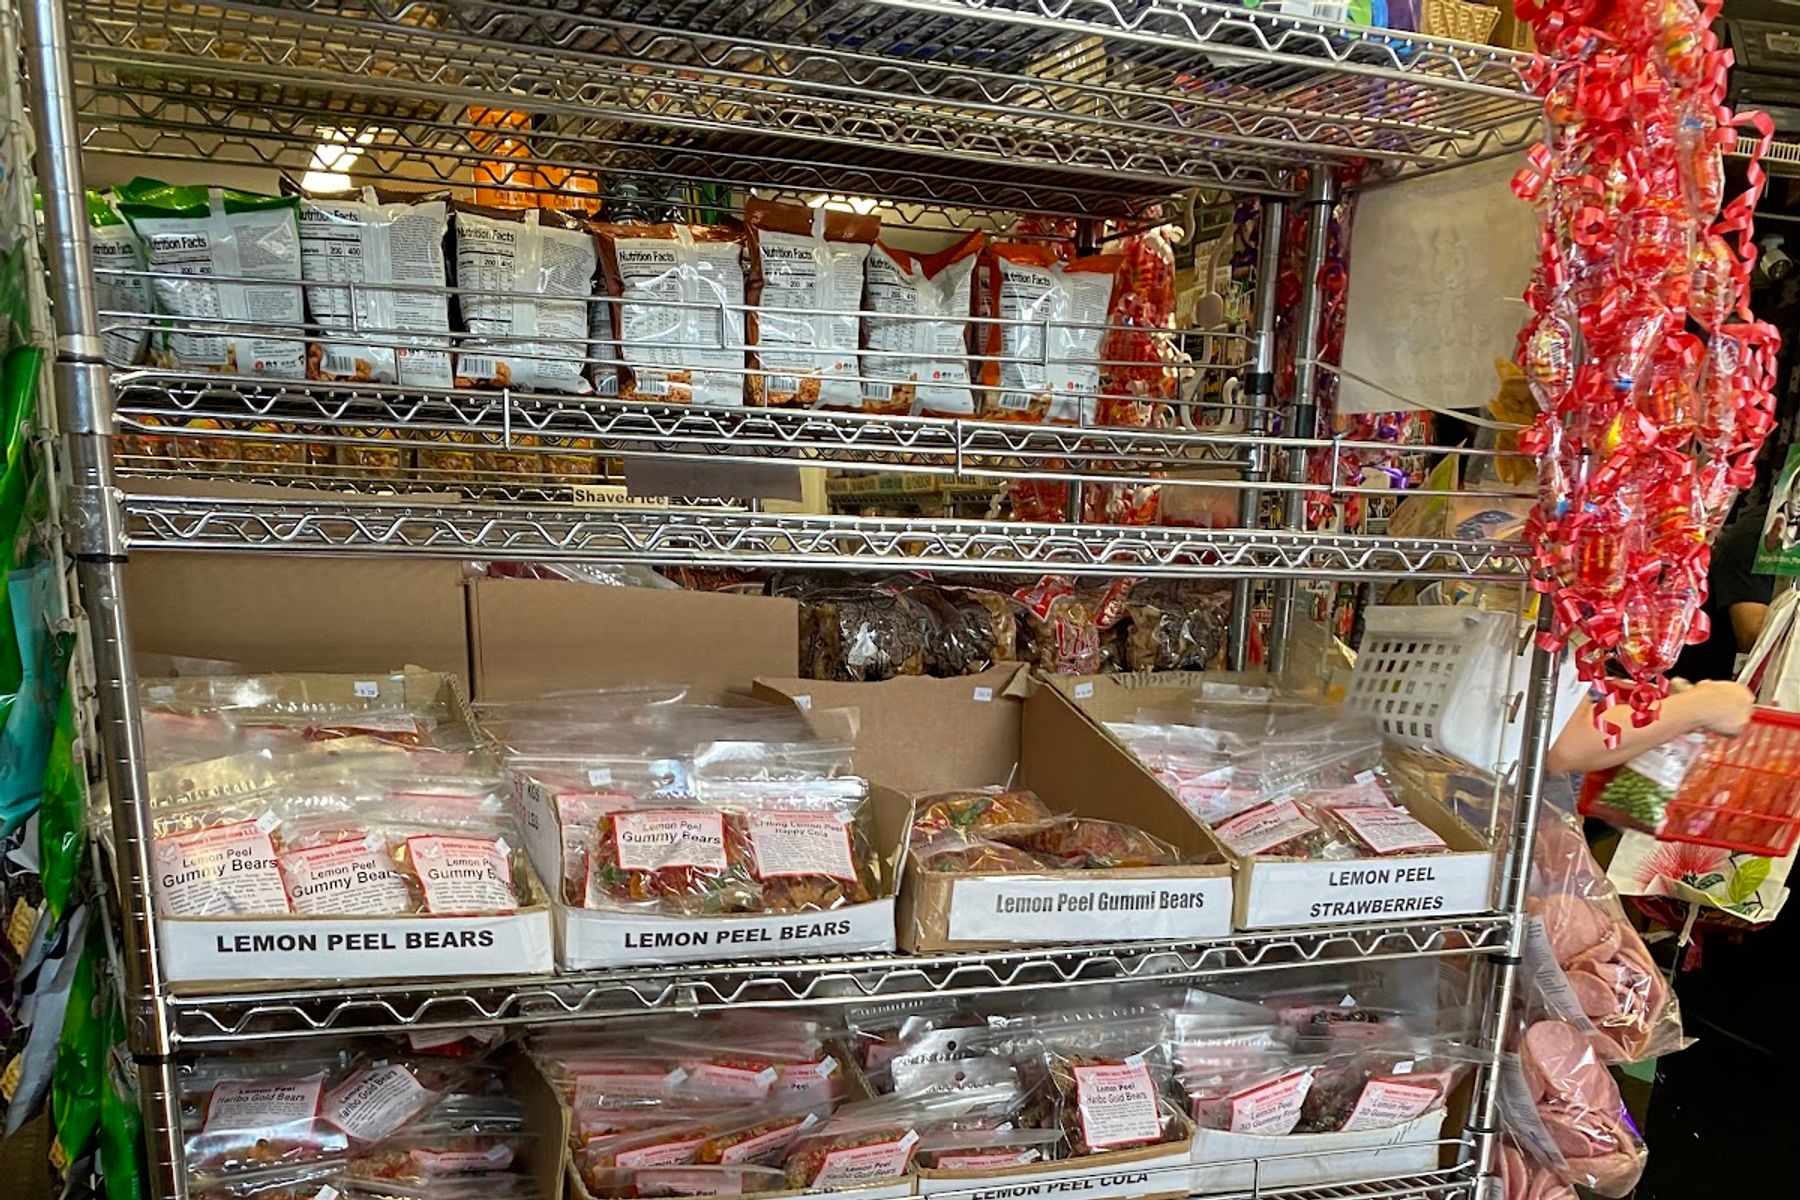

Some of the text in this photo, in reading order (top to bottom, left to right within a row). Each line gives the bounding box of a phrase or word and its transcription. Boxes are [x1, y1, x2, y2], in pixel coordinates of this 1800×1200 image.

[181, 236, 207, 249] Facts
[492, 229, 514, 242] Facts
[619, 250, 675, 263] Nutrition Facts
[762, 246, 813, 260] Nutrition Facts
[642, 822, 677, 831] Lemon
[622, 831, 678, 844] Gummy
[183, 847, 252, 868] Lemon Peel
[446, 858, 480, 866] Lemon
[162, 859, 278, 888] Gummy Bears
[311, 859, 376, 880] Lemon Peel
[428, 868, 483, 880] Gummy
[1329, 867, 1435, 887] LEMON PEEL
[292, 877, 352, 898] Gummy
[996, 890, 1205, 914] Lemon Peel Gummi Bears
[1310, 896, 1443, 918] STRAWBERRIES
[216, 929, 494, 953] LEMON PEEL BEARS
[624, 920, 851, 948] LEMON PEEL BEARS
[251, 1094, 276, 1103] Gold
[277, 1094, 305, 1102] Bears
[1251, 1107, 1277, 1120] Lemon
[874, 1160, 892, 1168] Peel
[1047, 1179, 1094, 1194] PEEL
[1101, 1173, 1149, 1188] COLA
